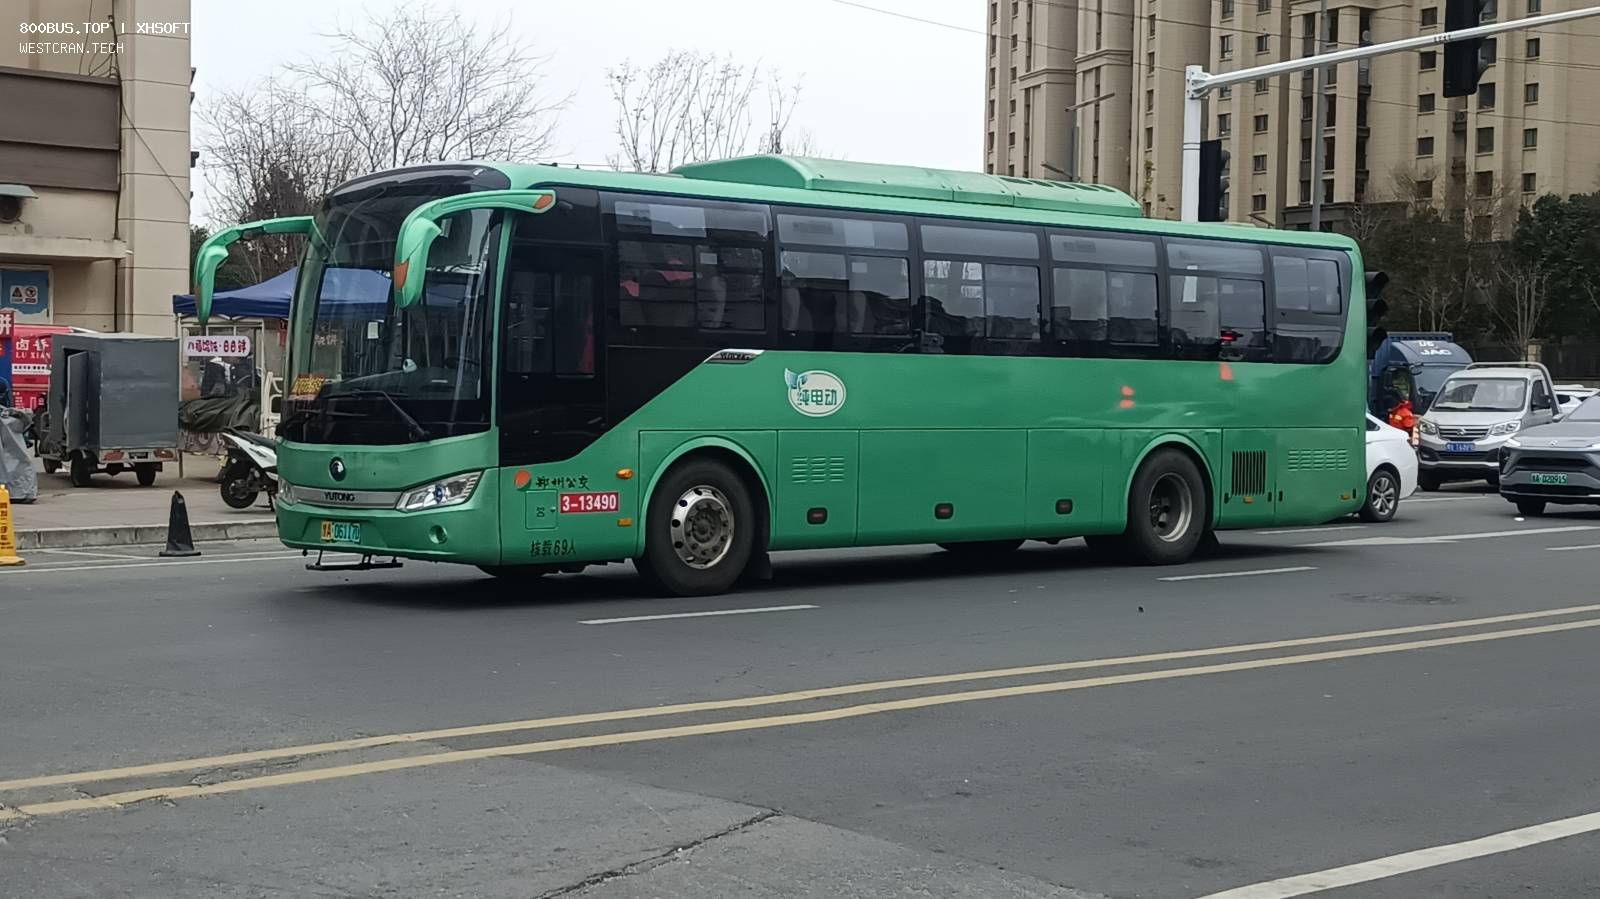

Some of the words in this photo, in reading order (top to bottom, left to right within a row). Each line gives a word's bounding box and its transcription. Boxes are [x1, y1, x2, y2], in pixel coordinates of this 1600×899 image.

[797, 388, 838, 406] 纯电动
[535, 475, 590, 490] 郑州公交
[324, 491, 355, 502] YUTONG
[562, 494, 617, 511] 3-13490
[530, 538, 577, 557] 核载69人
